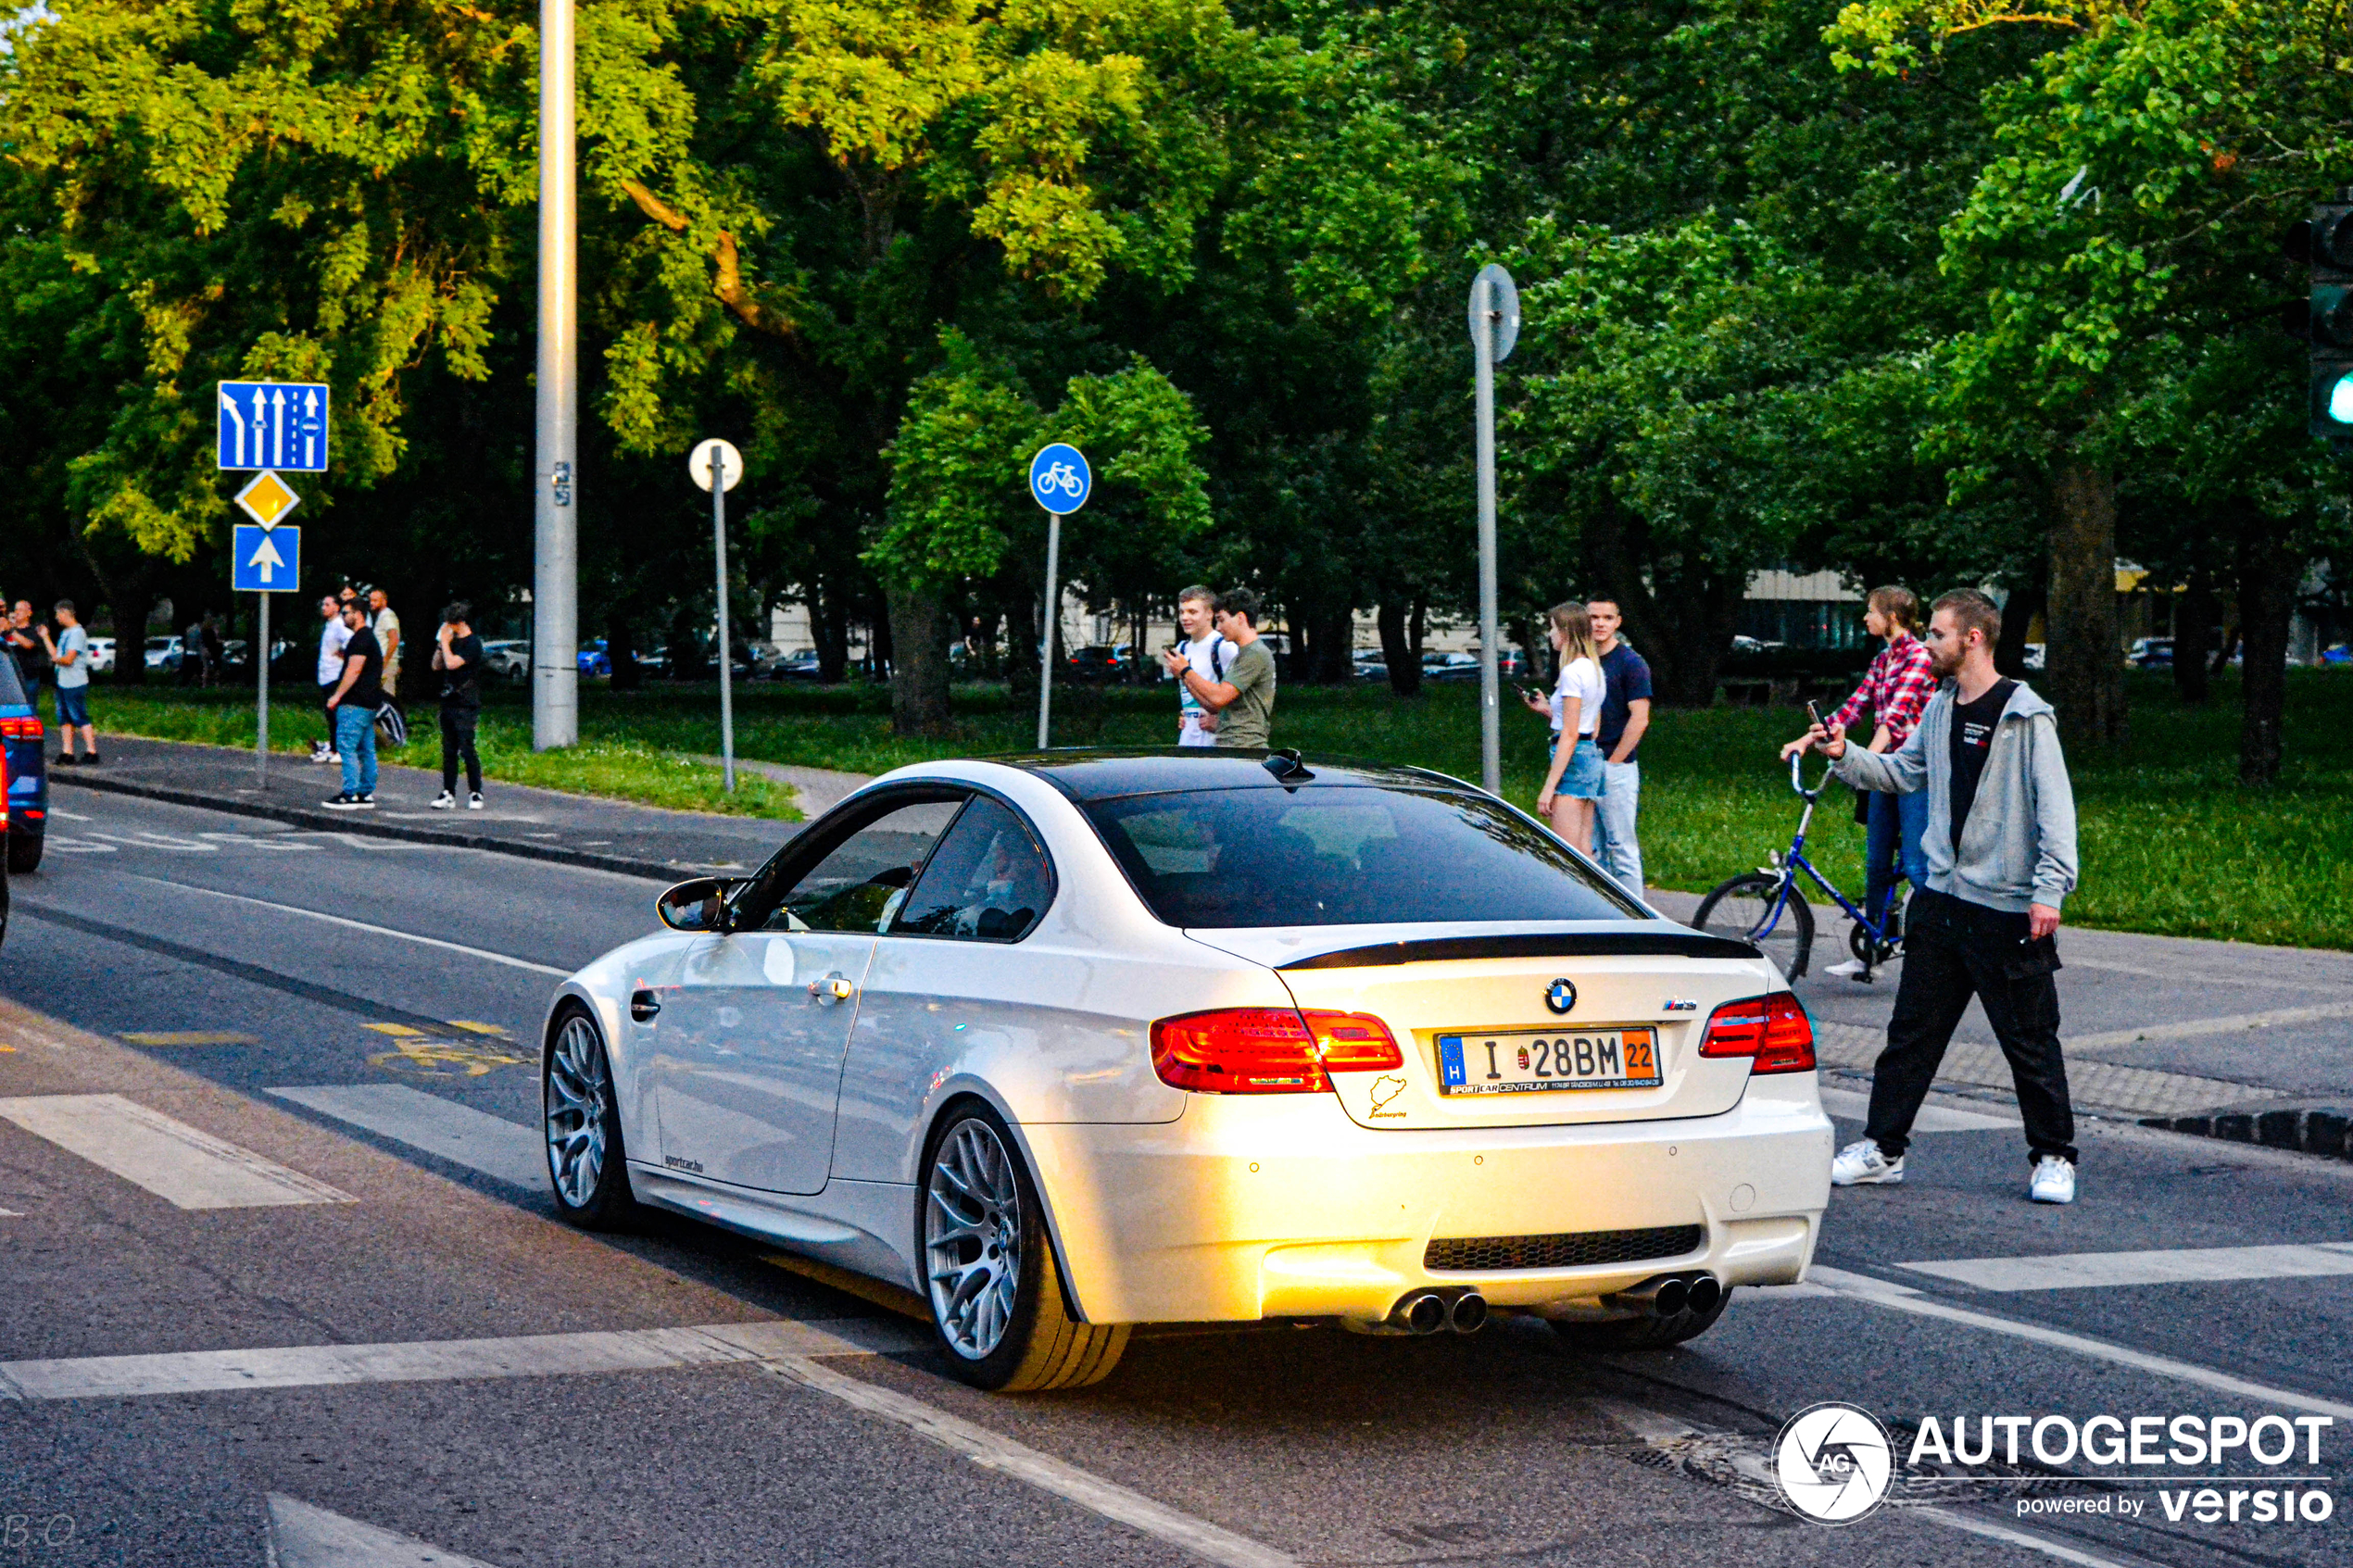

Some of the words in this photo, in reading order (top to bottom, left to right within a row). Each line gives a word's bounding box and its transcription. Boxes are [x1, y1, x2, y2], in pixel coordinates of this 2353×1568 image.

[1531, 1036, 1619, 1077] 28BM
[1626, 1042, 1652, 1067] 22
[1449, 1066, 1460, 1080] H
[1499, 1083, 1548, 1092] CENTRUM
[665, 1155, 704, 1173] sportcar.hu
